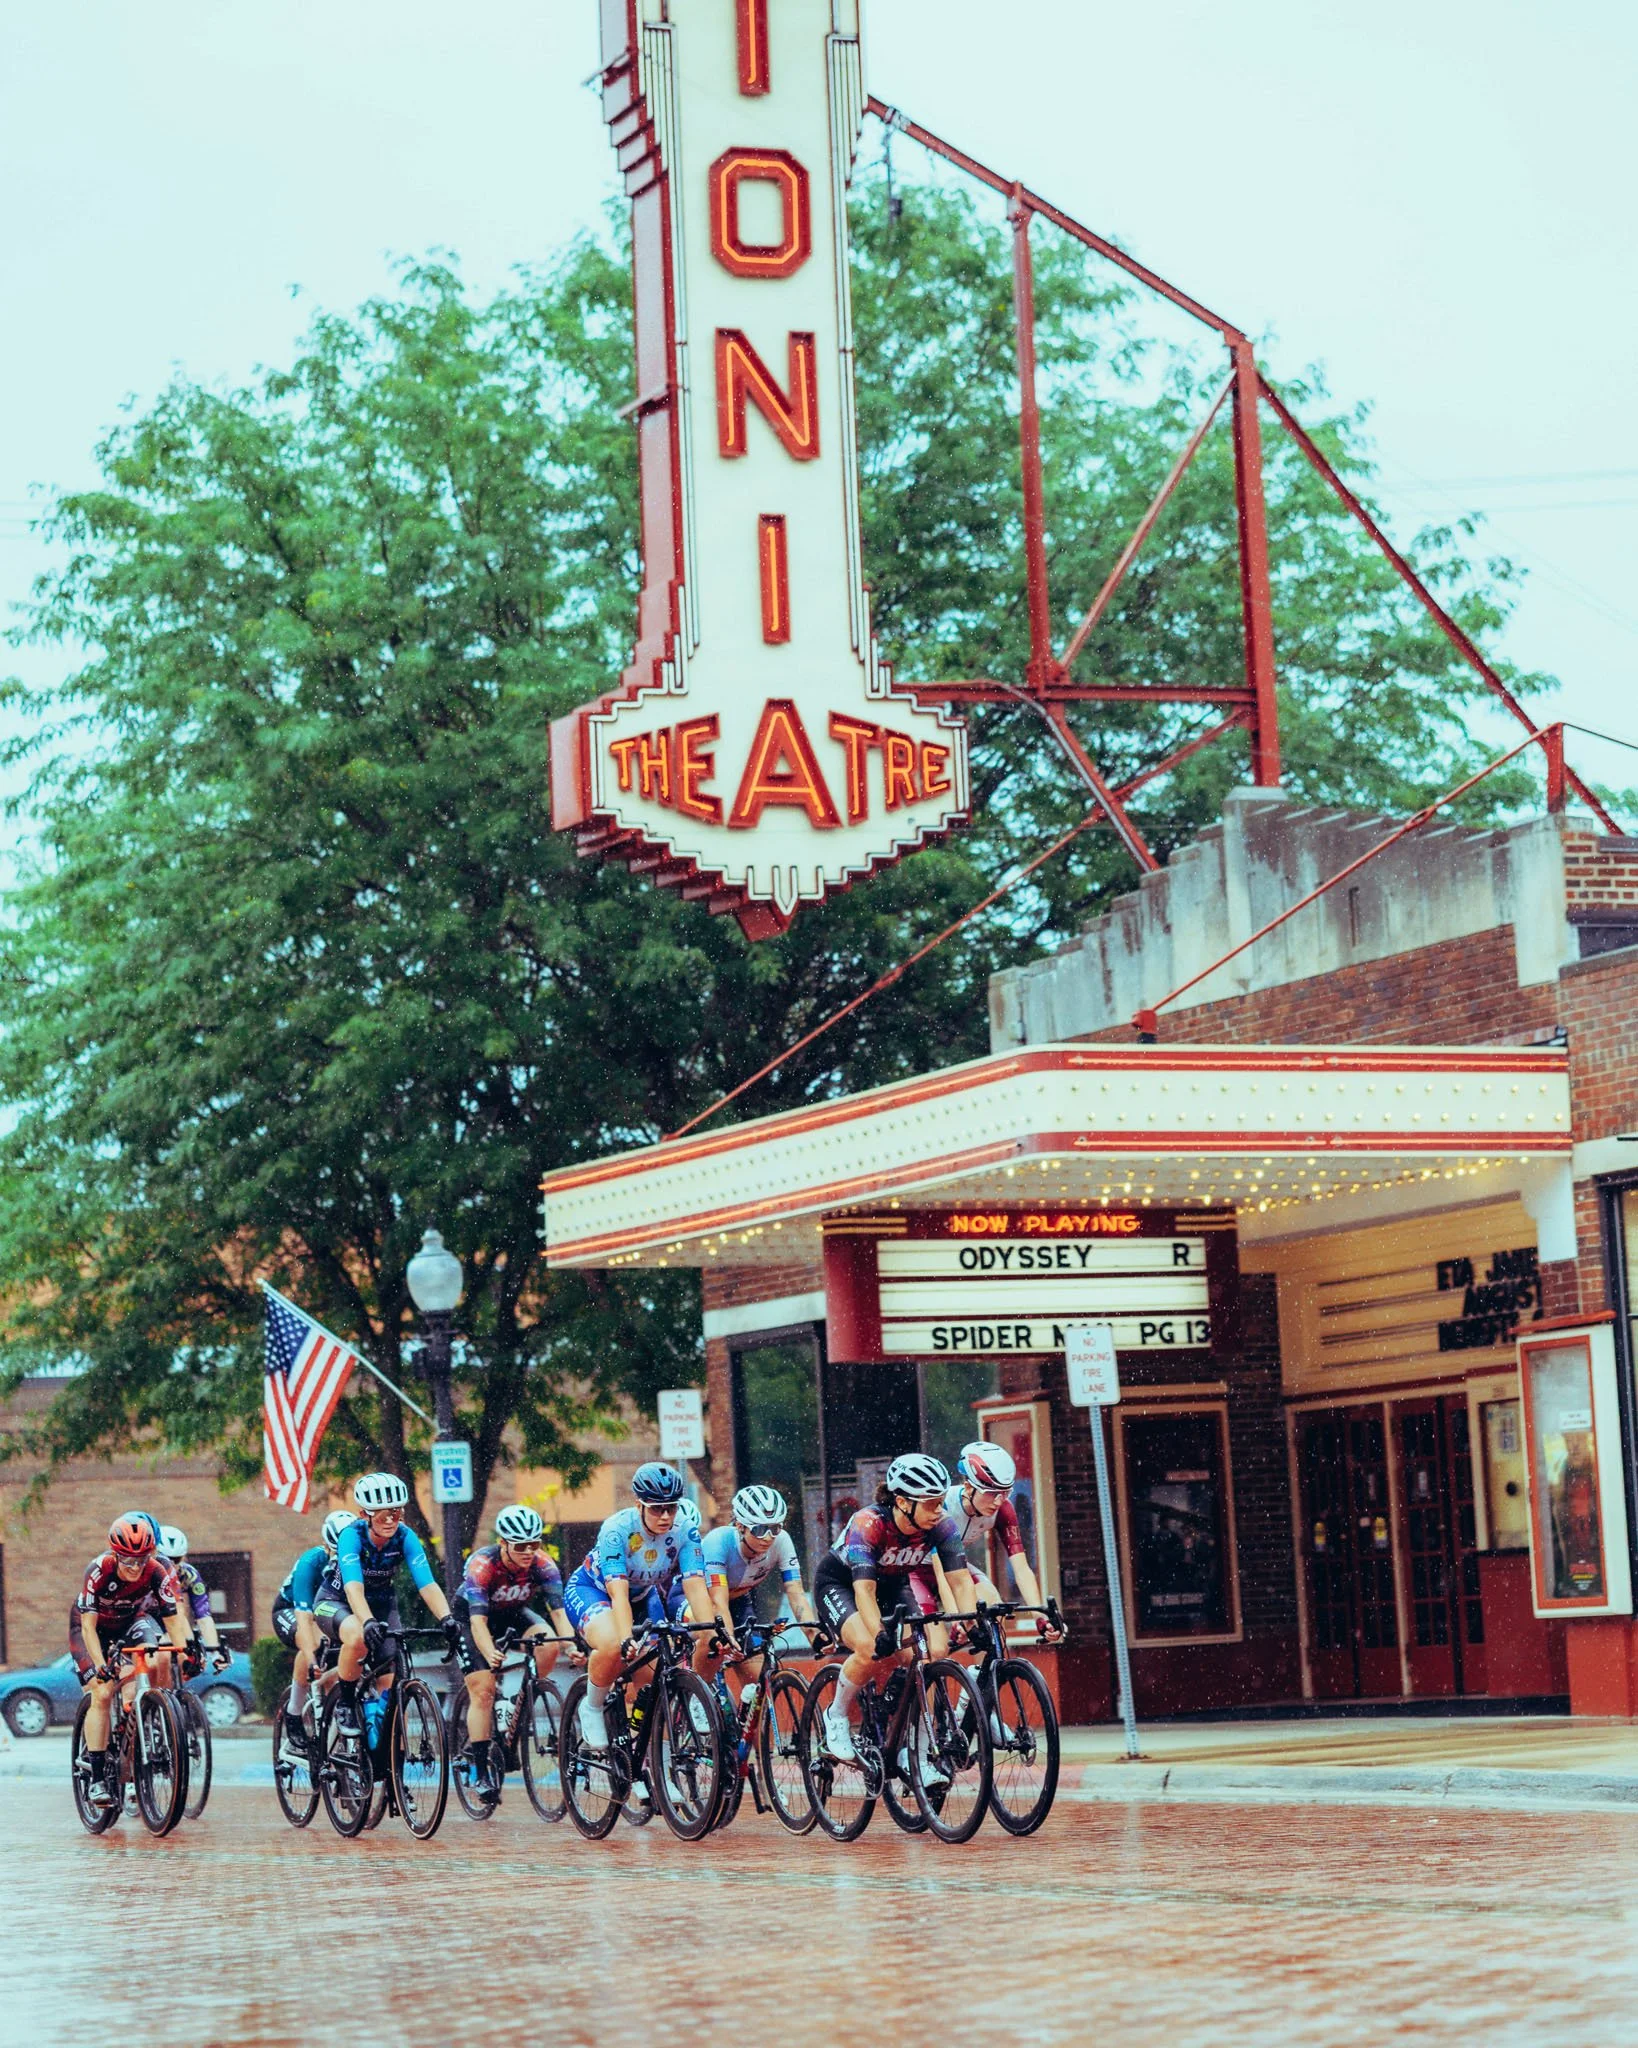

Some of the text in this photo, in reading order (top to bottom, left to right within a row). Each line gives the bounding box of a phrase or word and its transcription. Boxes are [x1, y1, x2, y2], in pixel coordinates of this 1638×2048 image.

[609, 697, 953, 829] THEATRE
[950, 1214, 1139, 1234] NOW PLAYING
[959, 1242, 1191, 1270] ODYSSEY R
[932, 1323, 1032, 1351] SPIDER
[1140, 1321, 1175, 1345] PG
[1071, 1352, 1111, 1363] PARKING
[1082, 1368, 1103, 1378] FIRE
[1082, 1384, 1107, 1394] LANE
